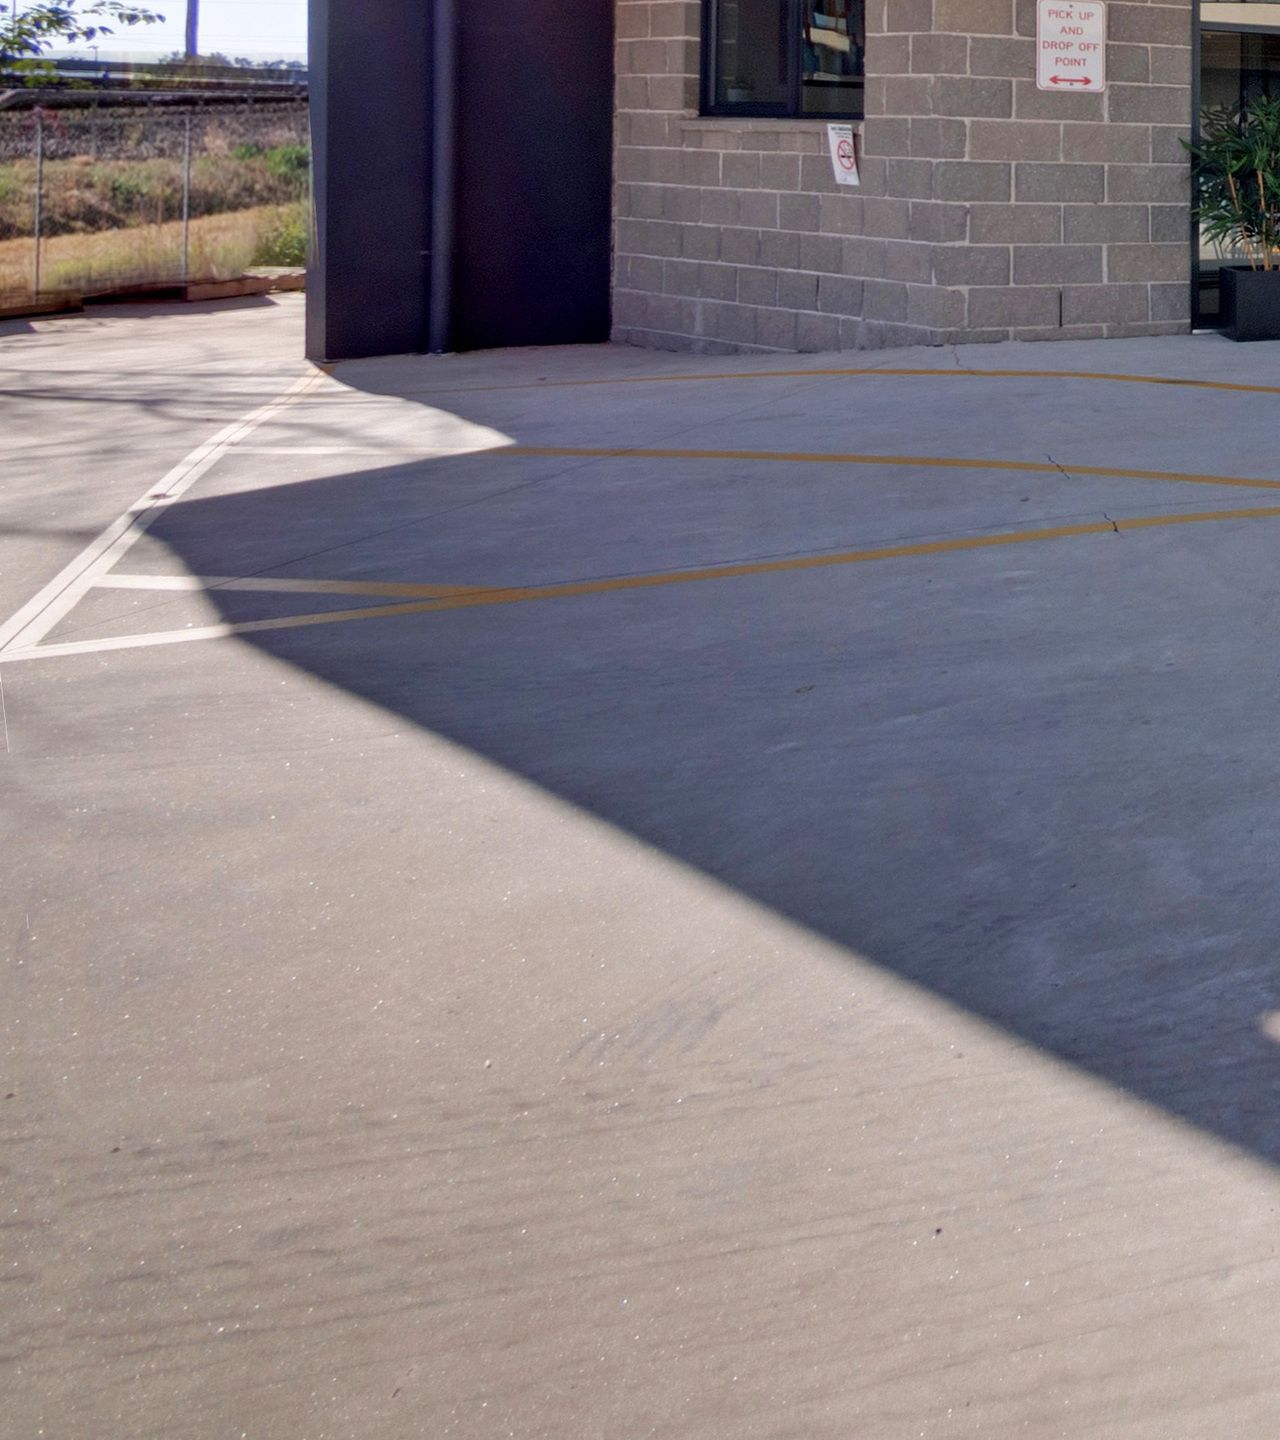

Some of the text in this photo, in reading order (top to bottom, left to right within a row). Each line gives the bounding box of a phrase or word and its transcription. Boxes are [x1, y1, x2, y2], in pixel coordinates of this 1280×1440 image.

[1048, 9, 1094, 20] PICK UP
[1060, 26, 1084, 35] AND
[1042, 40, 1100, 51] DROP OFF
[1055, 56, 1088, 66] POINT
